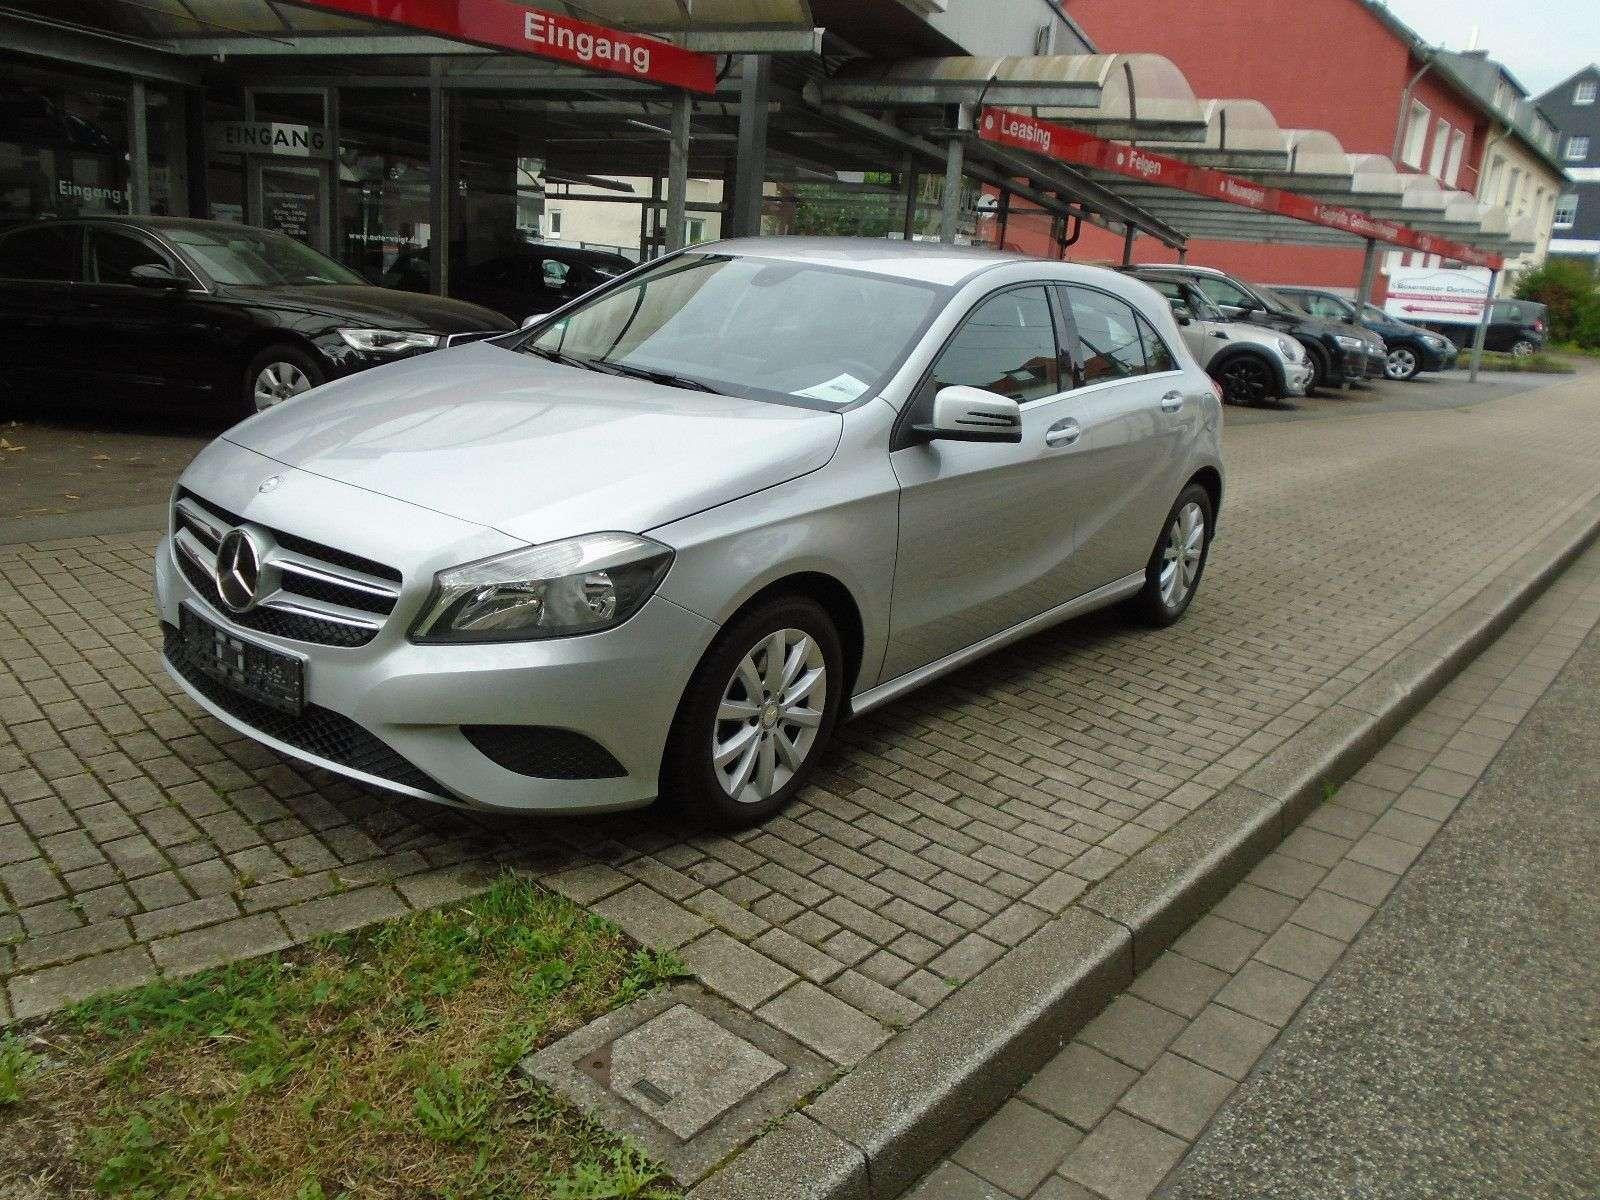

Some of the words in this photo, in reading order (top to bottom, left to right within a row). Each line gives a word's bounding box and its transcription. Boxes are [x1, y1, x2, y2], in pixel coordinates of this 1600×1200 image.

[524, 11, 650, 74] Eingang
[225, 125, 324, 150] EINGANG
[1001, 115, 1051, 151] Leasing
[1128, 151, 1162, 177] Felgen
[58, 179, 122, 204] Eingang
